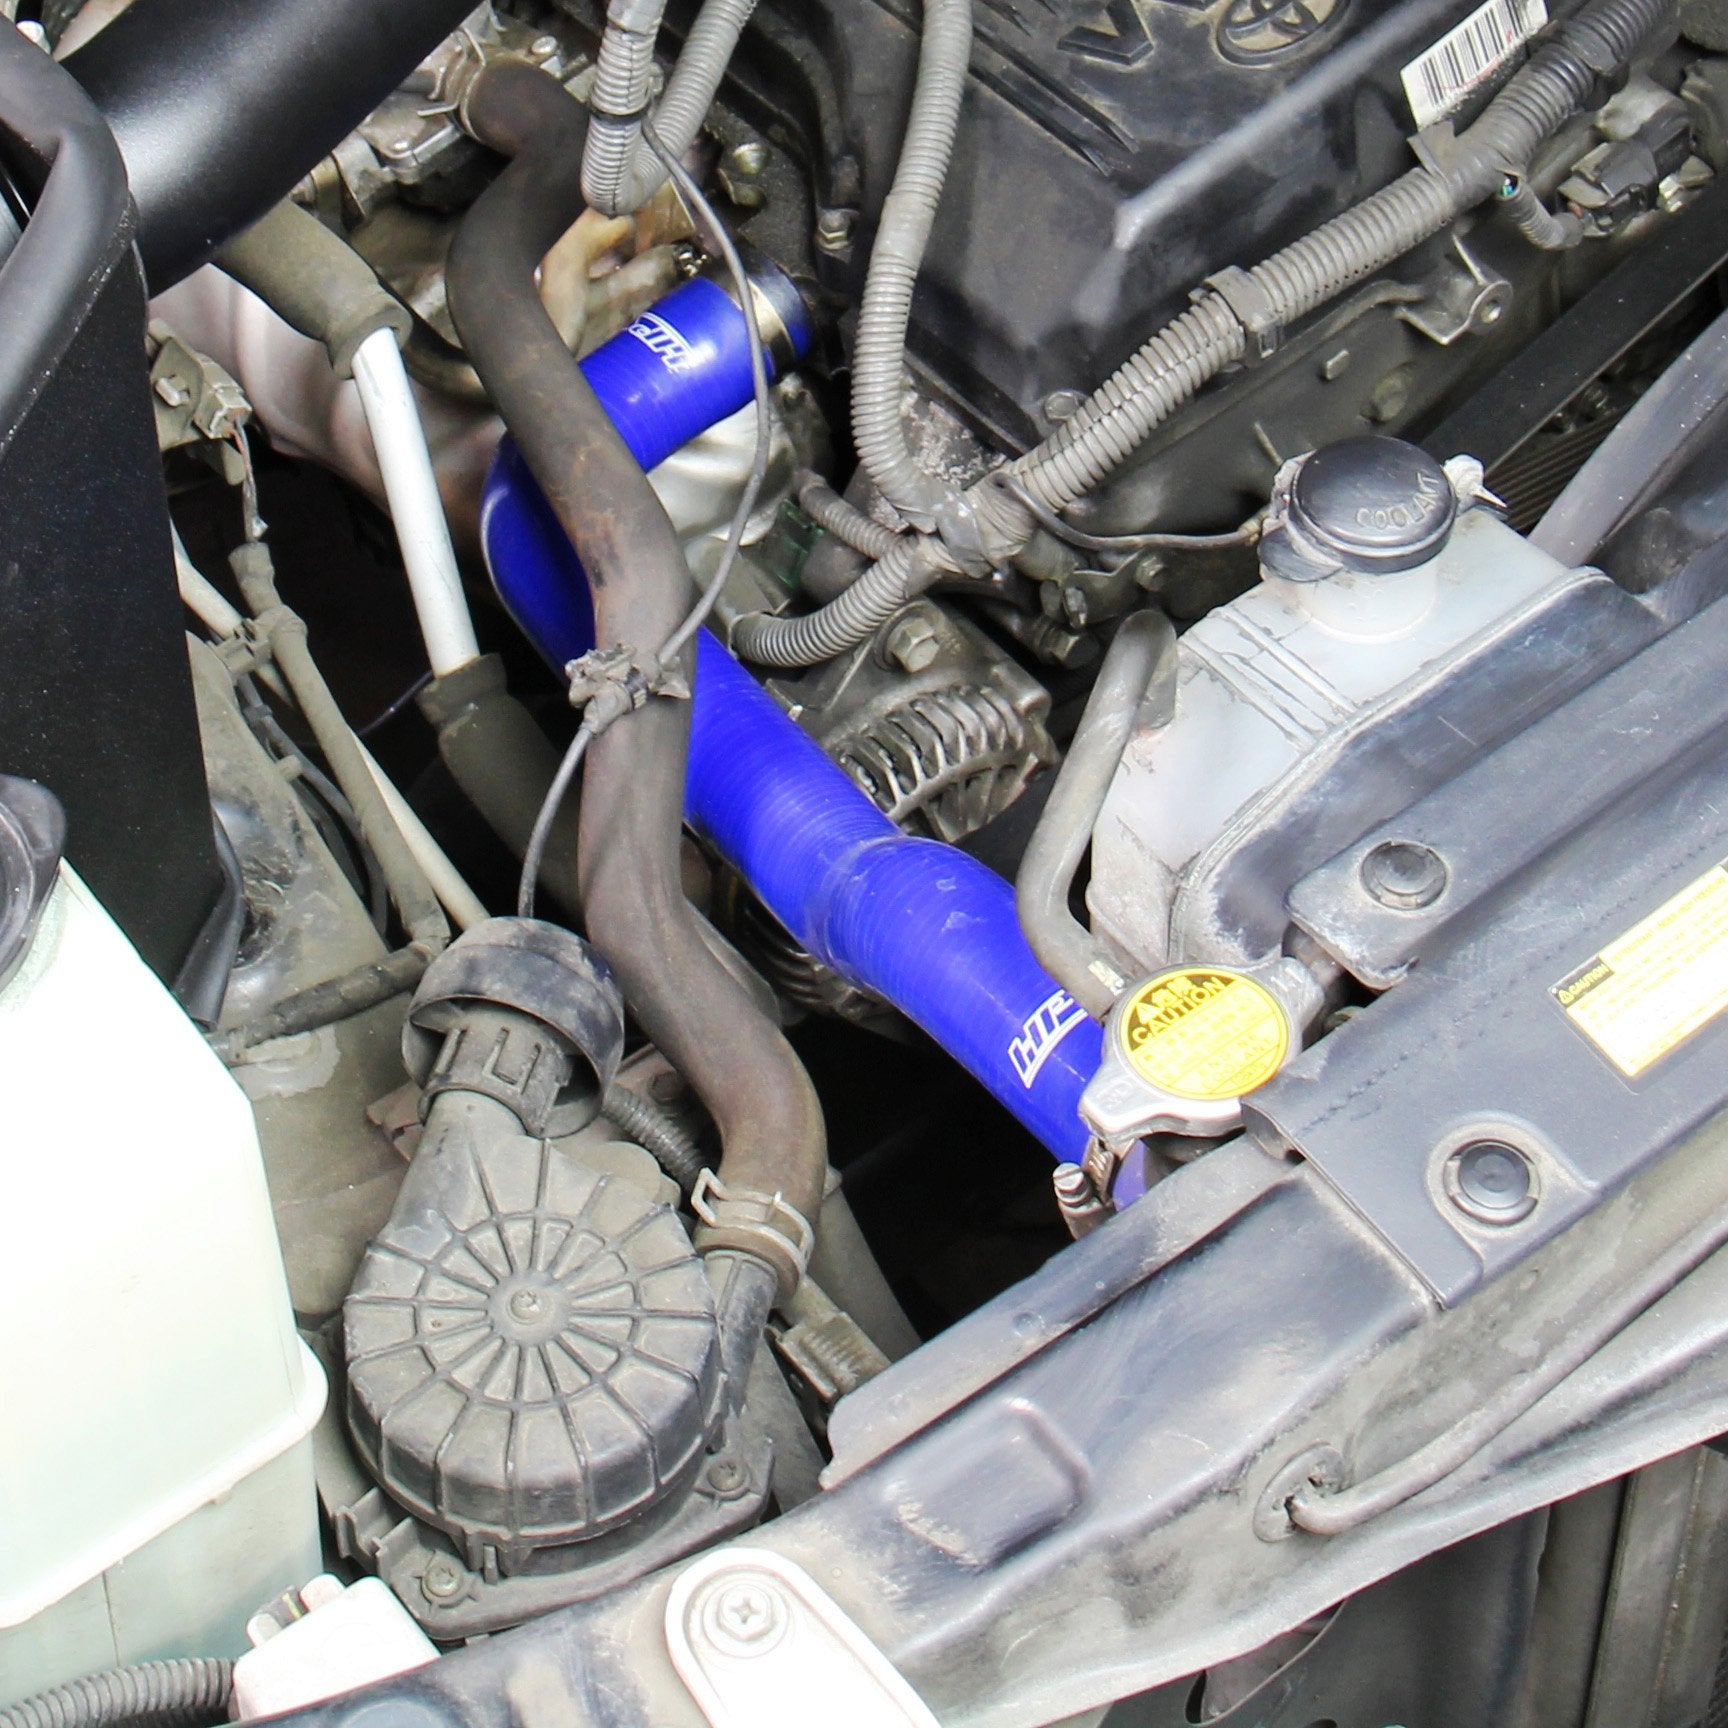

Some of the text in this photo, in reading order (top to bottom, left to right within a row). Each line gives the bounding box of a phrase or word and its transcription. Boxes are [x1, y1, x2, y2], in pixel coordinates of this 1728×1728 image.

[628, 312, 702, 373] HP
[1355, 471, 1440, 530] COOLANT
[1008, 988, 1089, 1088] HP
[1132, 976, 1226, 1044] CAUTION
